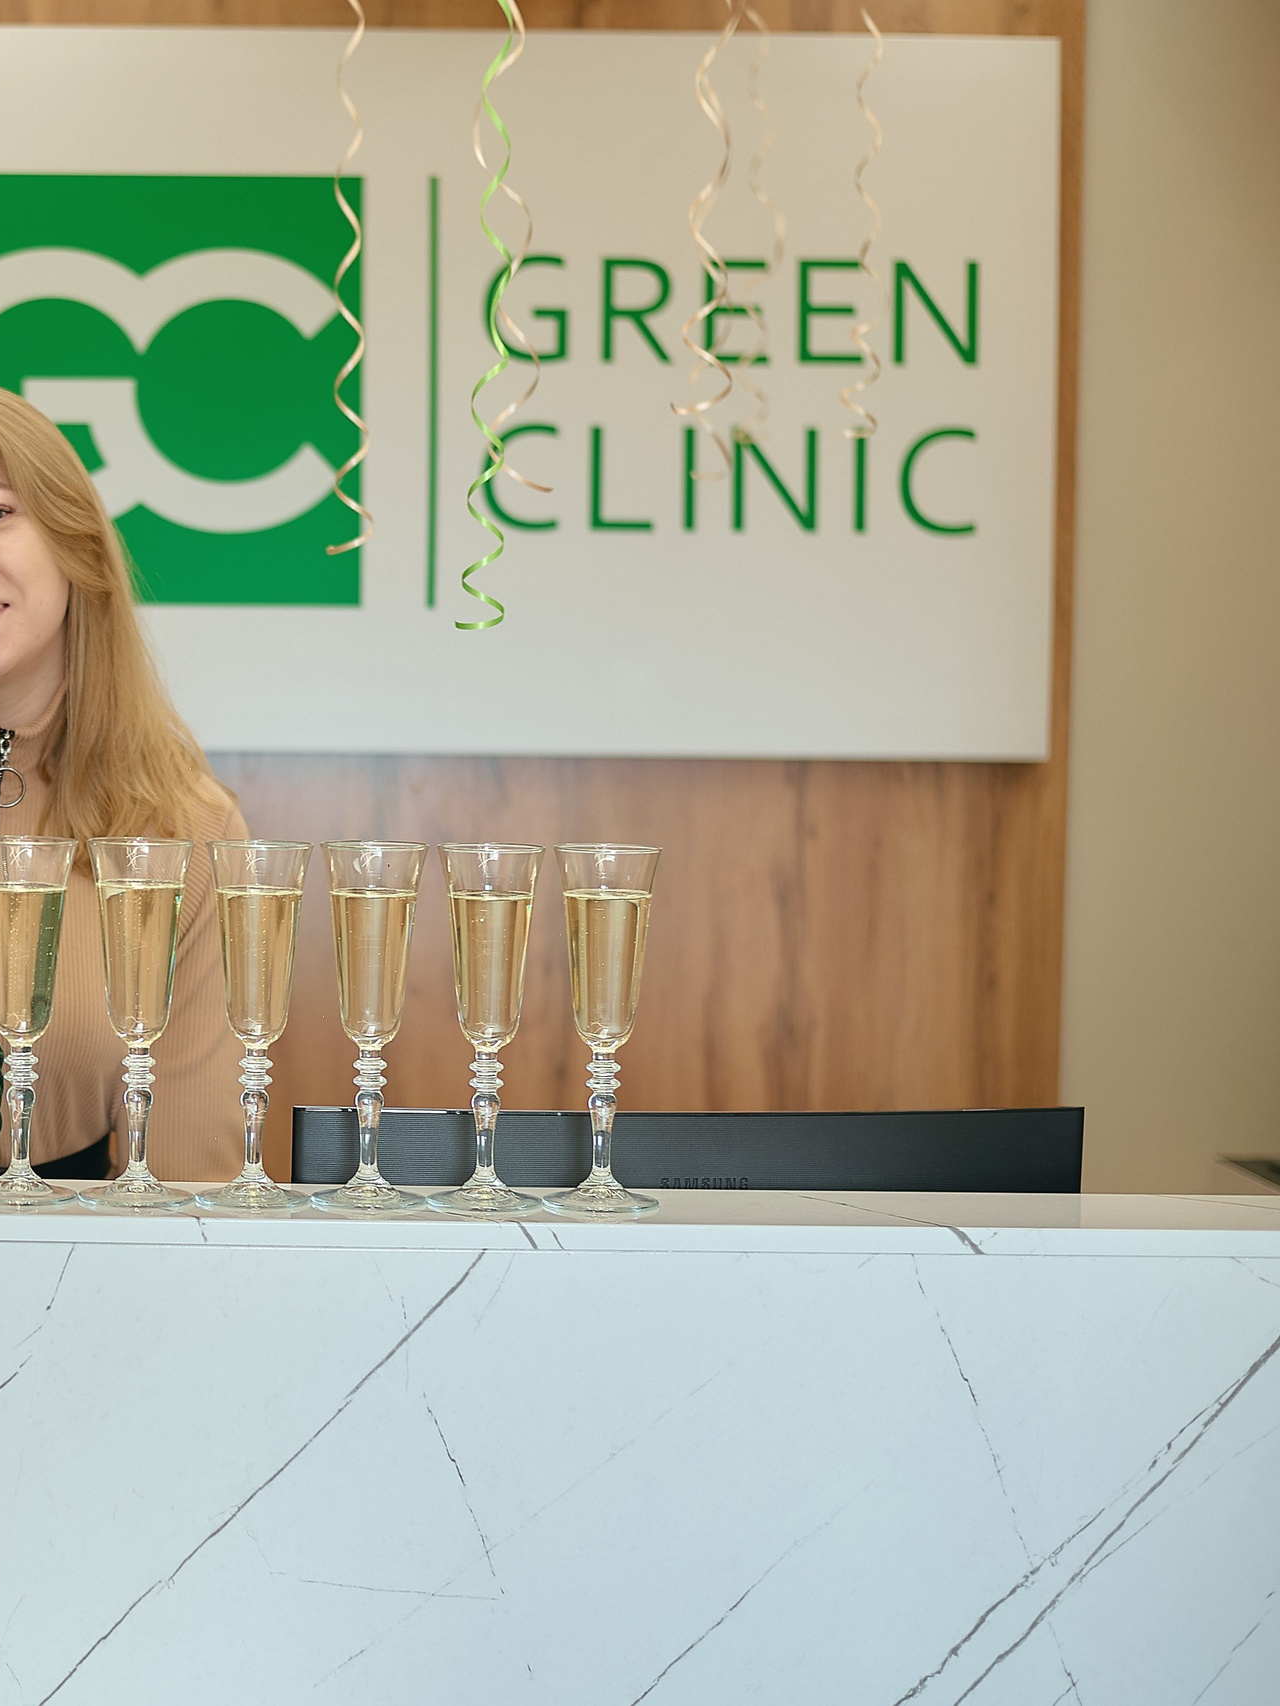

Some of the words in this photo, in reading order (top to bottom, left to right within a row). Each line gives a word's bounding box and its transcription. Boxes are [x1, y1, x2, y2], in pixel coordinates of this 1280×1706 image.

[485, 255, 980, 366] GREEN
[482, 424, 978, 535] CLINIC
[660, 1177, 749, 1189] SAMSUNG
